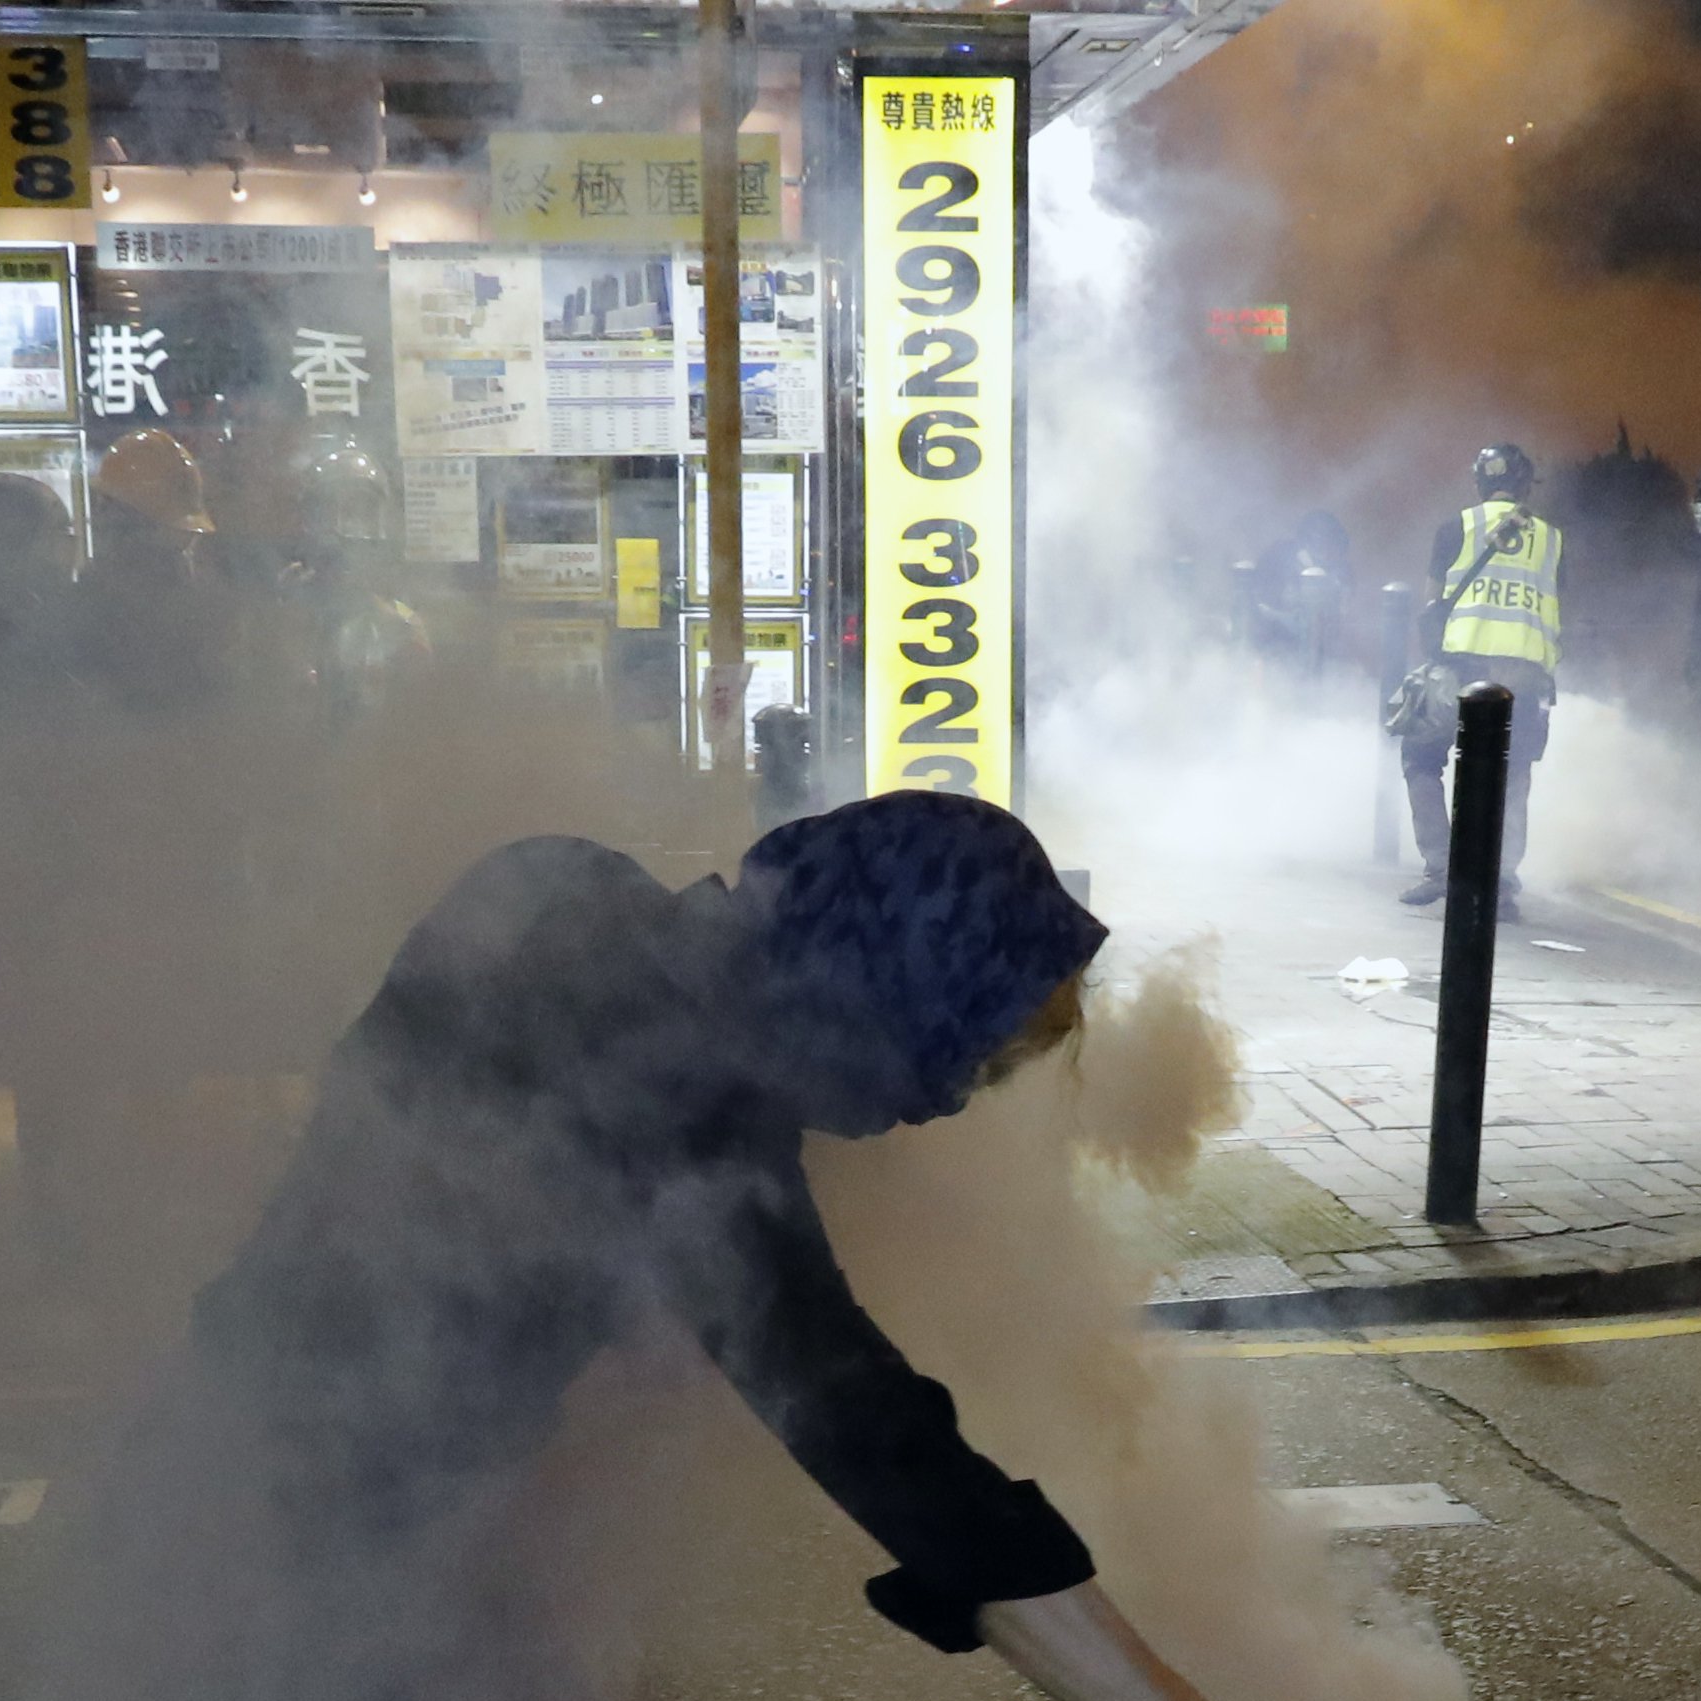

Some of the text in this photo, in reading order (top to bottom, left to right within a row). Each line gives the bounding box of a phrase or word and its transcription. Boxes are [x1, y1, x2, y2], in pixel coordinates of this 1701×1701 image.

[882, 91, 995, 131] 尊貴熱線
[895, 161, 982, 479] 2926
